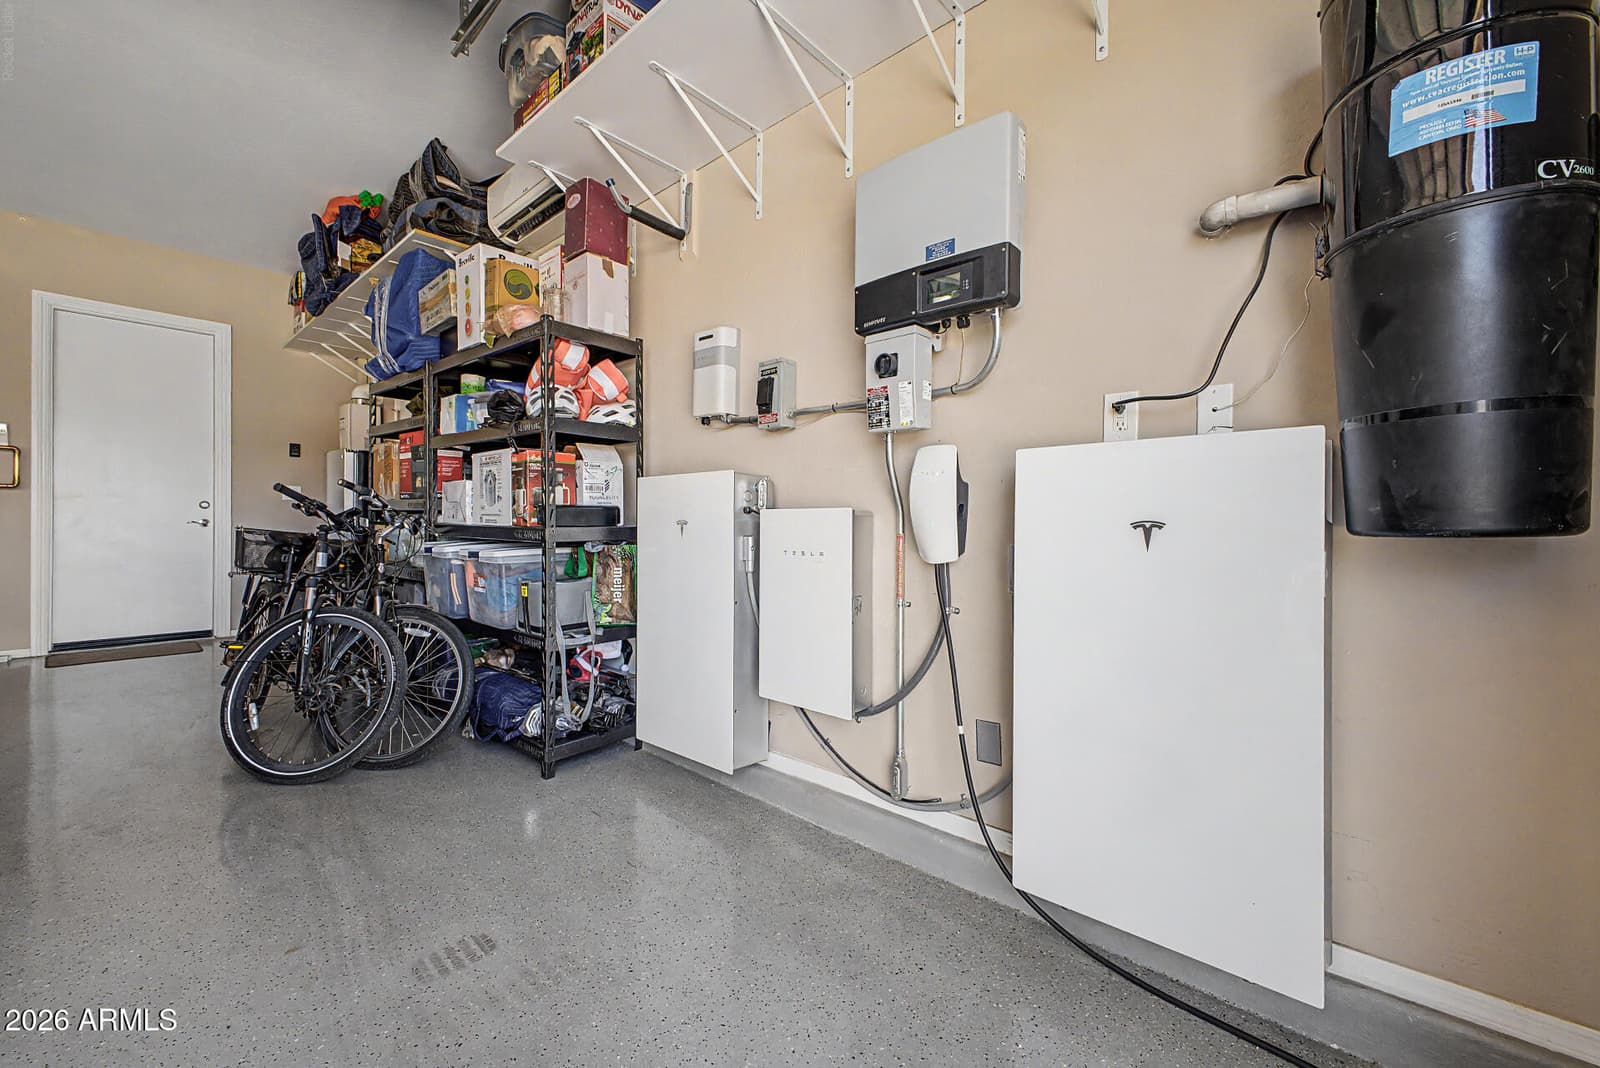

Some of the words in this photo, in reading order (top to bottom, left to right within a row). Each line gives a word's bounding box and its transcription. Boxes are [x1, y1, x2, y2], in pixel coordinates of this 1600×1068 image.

[1425, 49, 1506, 85] REGISTER
[783, 549, 825, 557] TESLA
[611, 567, 625, 604] meijer
